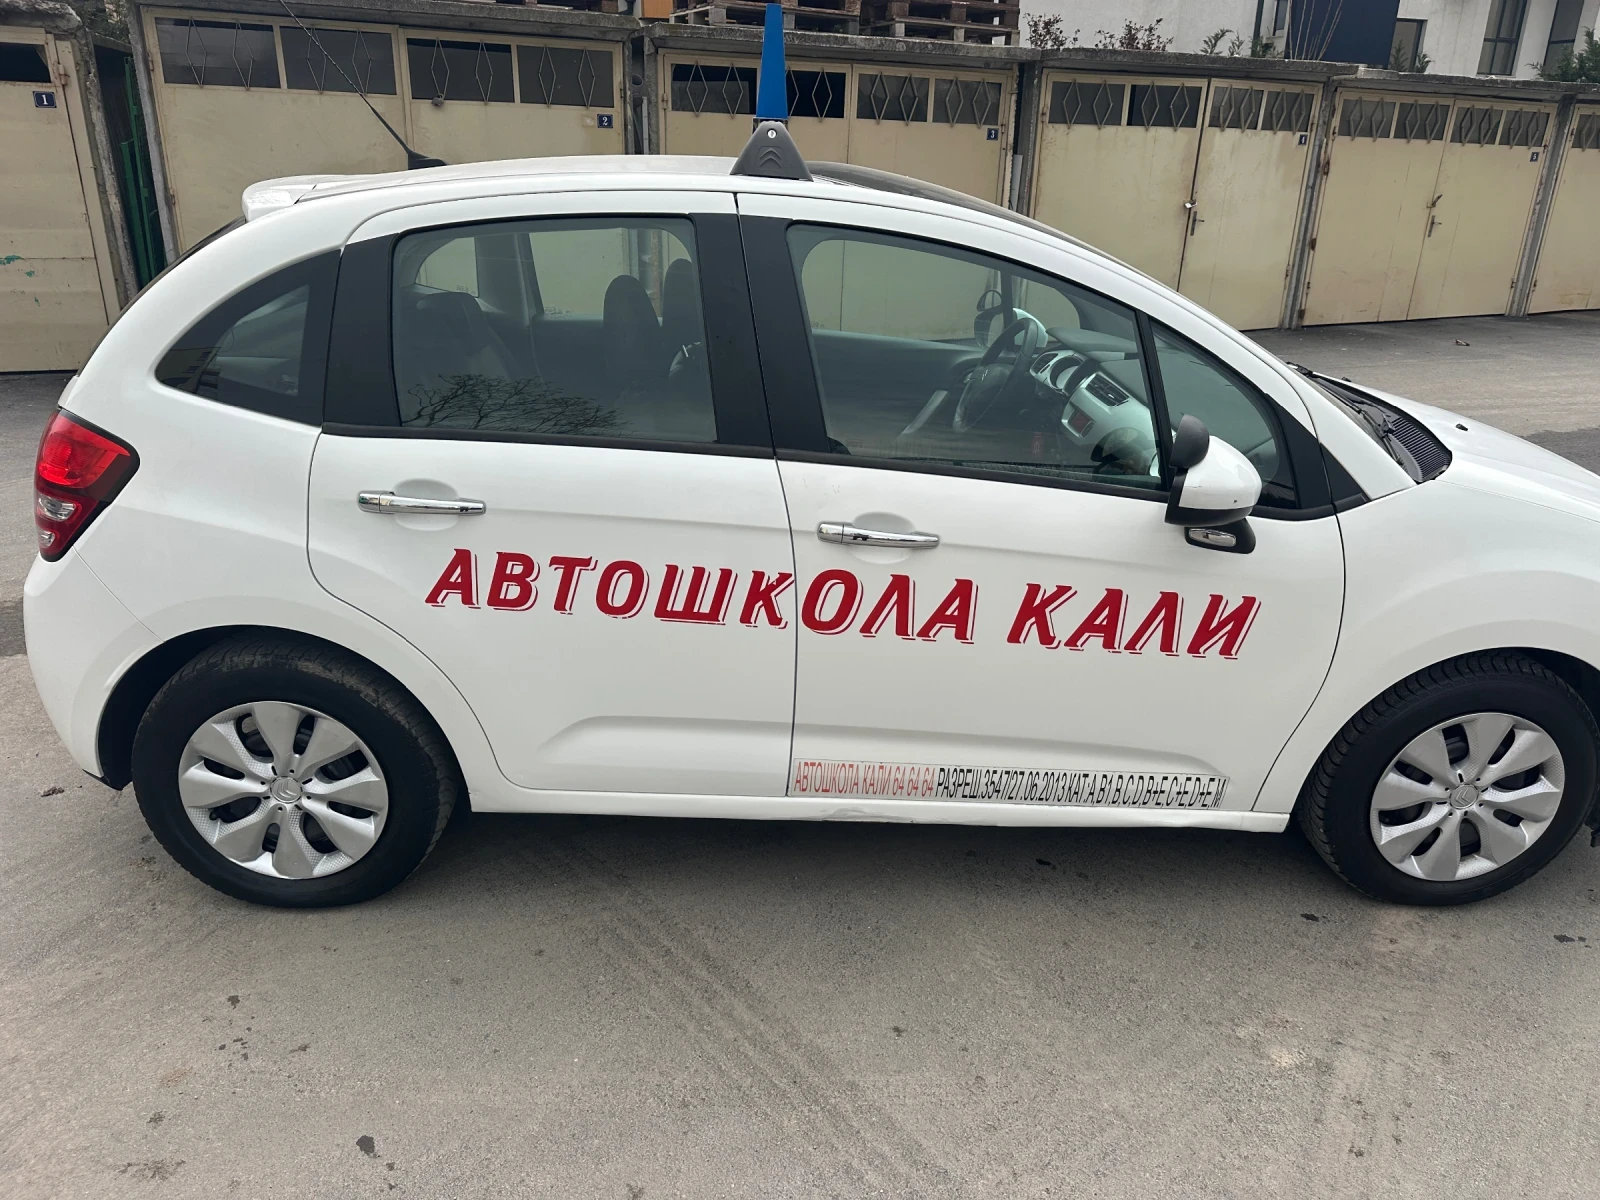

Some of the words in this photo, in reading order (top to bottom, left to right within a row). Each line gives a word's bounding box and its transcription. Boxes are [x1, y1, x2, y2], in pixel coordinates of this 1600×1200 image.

[425, 548, 979, 645] АВТОШКОЛА
[1006, 583, 1262, 660] КАЛИ
[794, 762, 860, 794] АВТОШКОЛА
[861, 764, 894, 796] КАЛИ
[892, 766, 906, 796] 64
[906, 766, 920, 797] 64
[921, 767, 936, 798] 64
